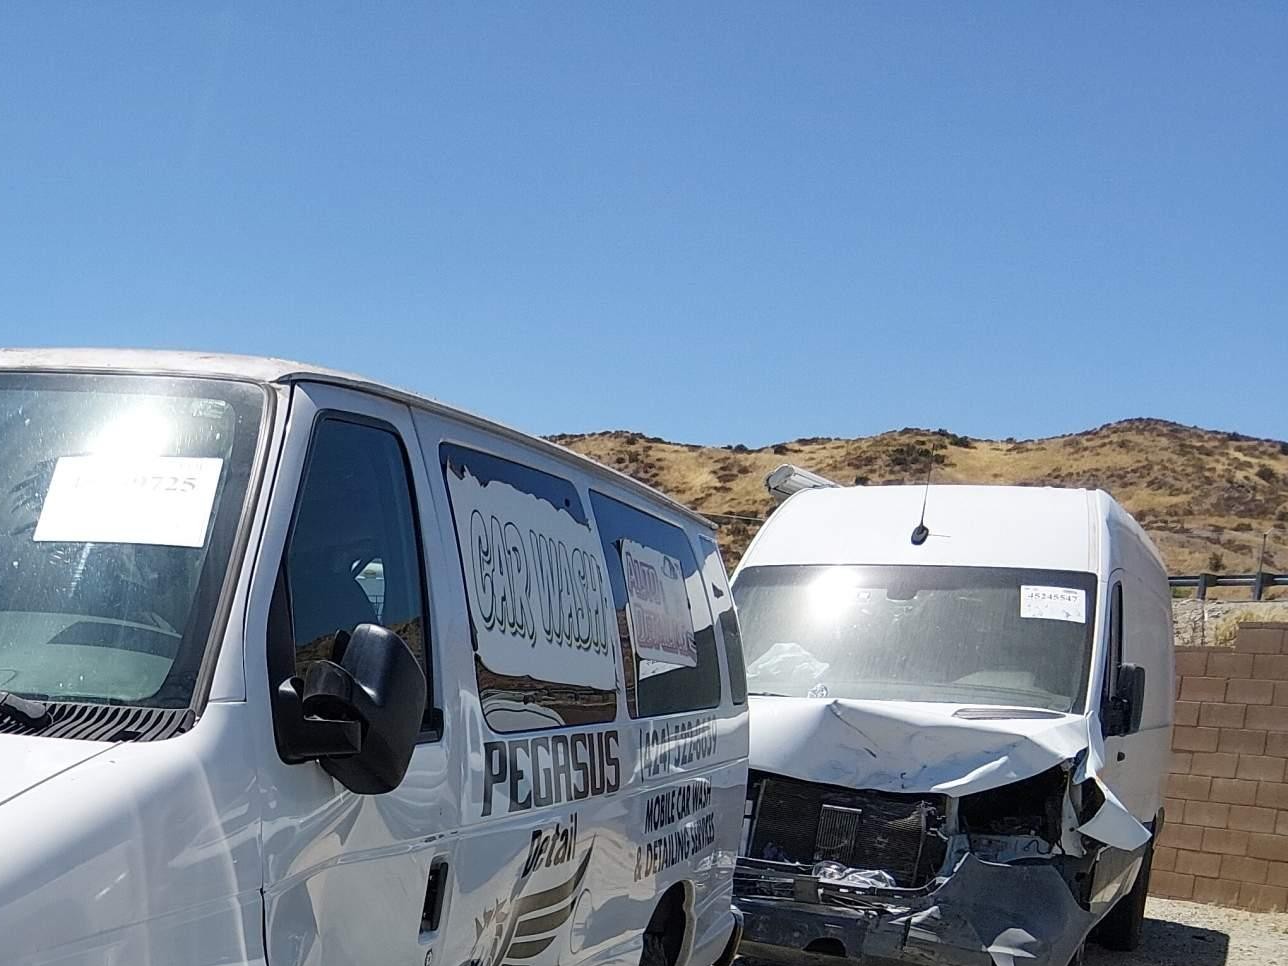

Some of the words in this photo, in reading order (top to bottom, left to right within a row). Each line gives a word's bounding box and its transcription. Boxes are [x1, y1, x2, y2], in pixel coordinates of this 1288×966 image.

[470, 509, 536, 648] CAR
[529, 529, 609, 656] WASH
[480, 730, 620, 817] PEGASUS
[645, 789, 675, 834] MOBILE
[676, 785, 691, 820] CAR
[692, 776, 712, 813] WASH
[521, 812, 578, 878] Detail
[634, 846, 642, 882] &
[645, 825, 690, 878] DETAILING
